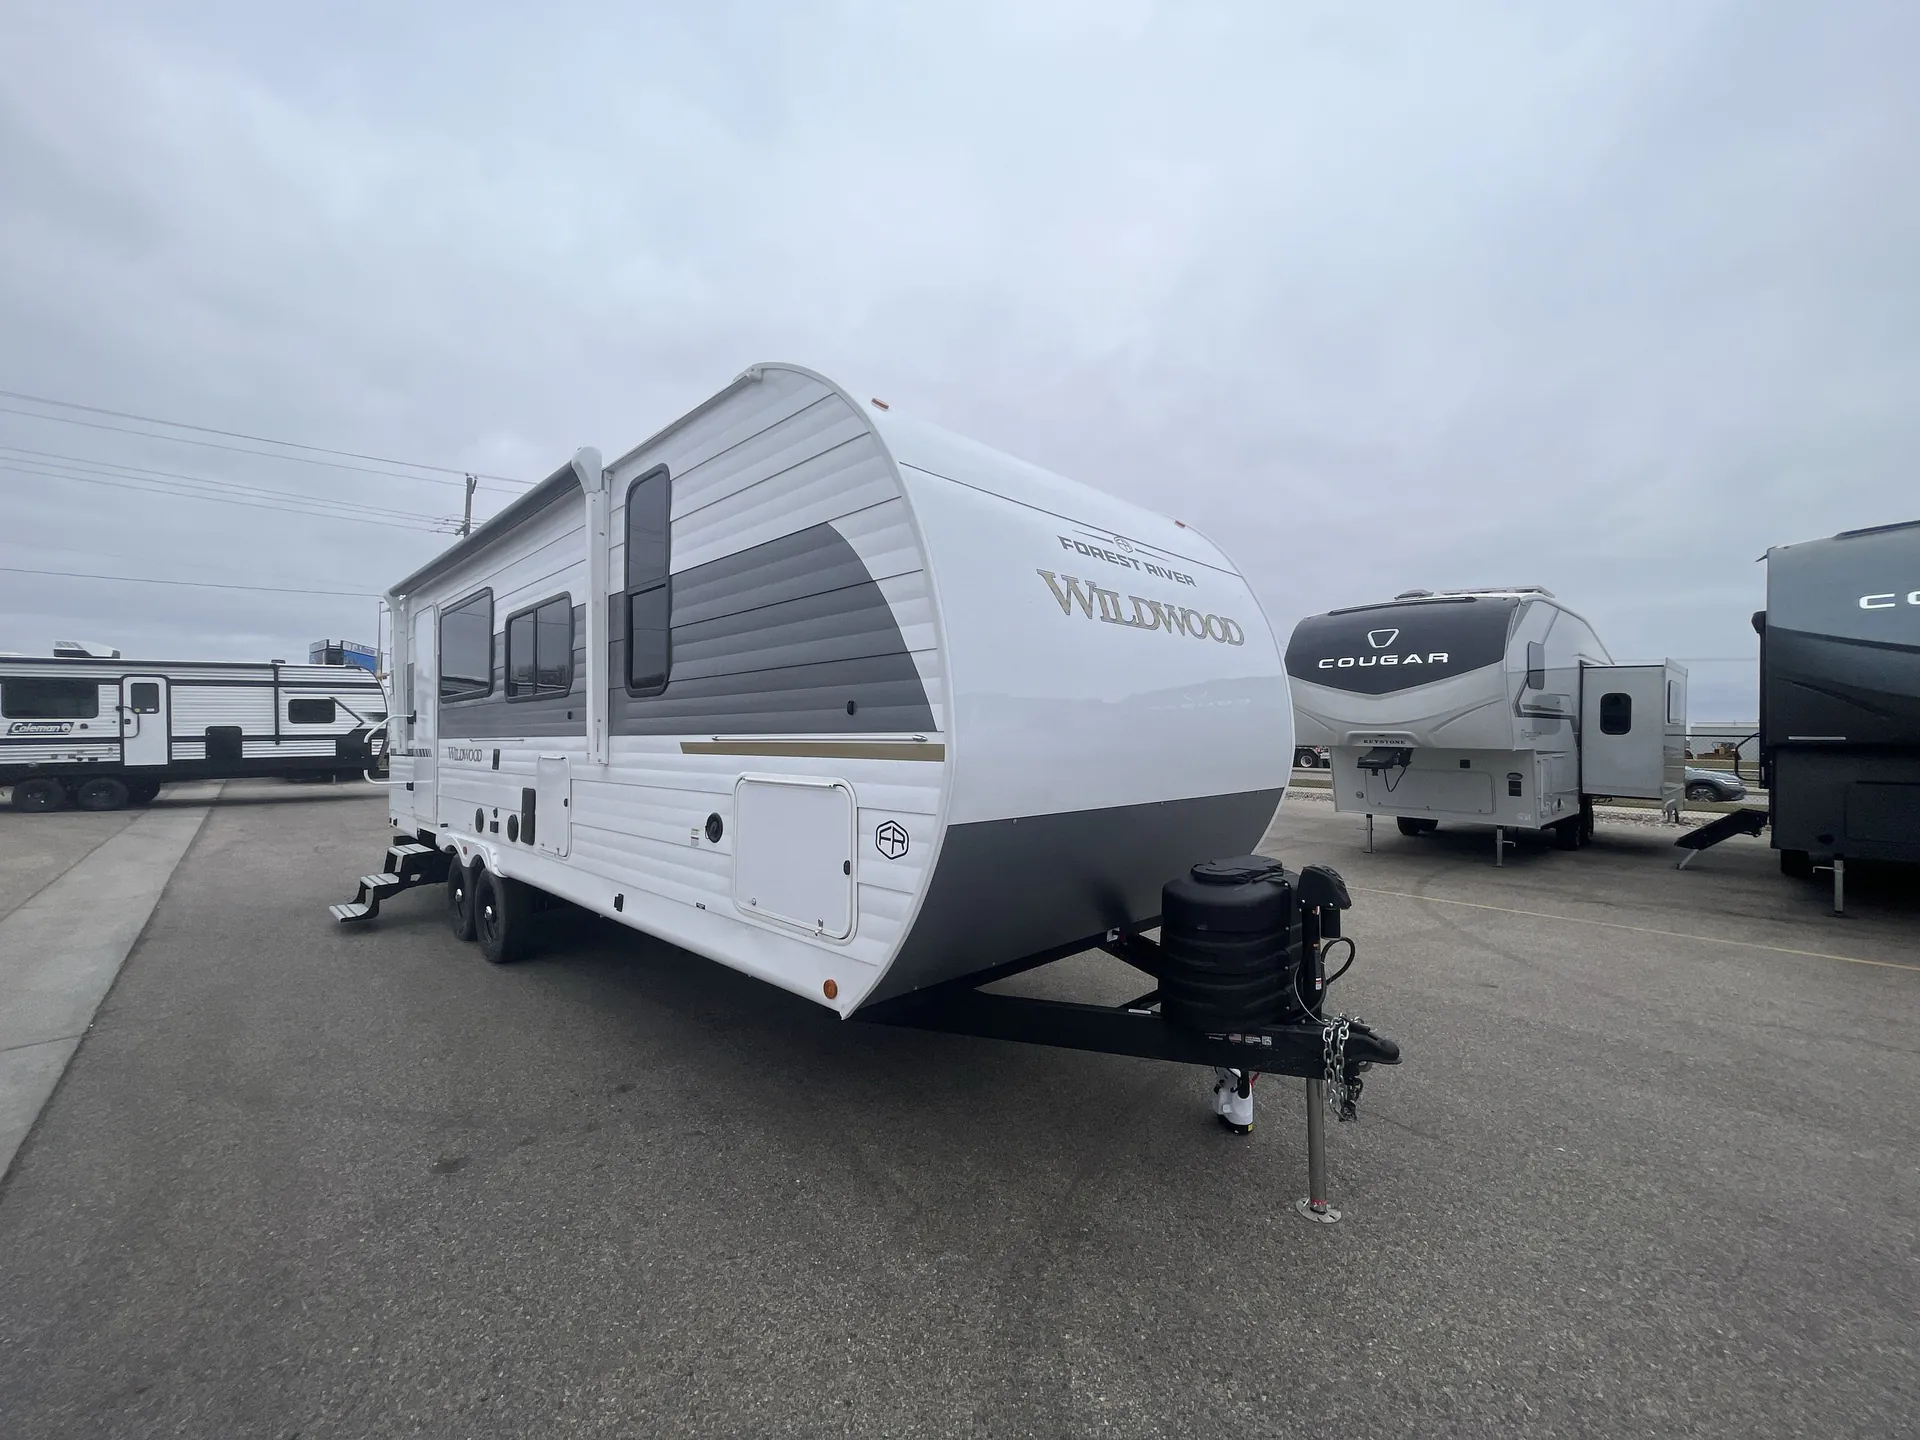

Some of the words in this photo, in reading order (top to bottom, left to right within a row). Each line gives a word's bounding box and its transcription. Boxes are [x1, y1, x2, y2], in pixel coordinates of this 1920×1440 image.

[1057, 535, 1141, 570] FOREST
[1143, 562, 1197, 587] RIVER
[1036, 569, 1245, 646] WILDWOOD
[1318, 653, 1449, 669] COUGAR
[12, 723, 60, 732] Coleman
[448, 747, 482, 762] WILDWOOD
